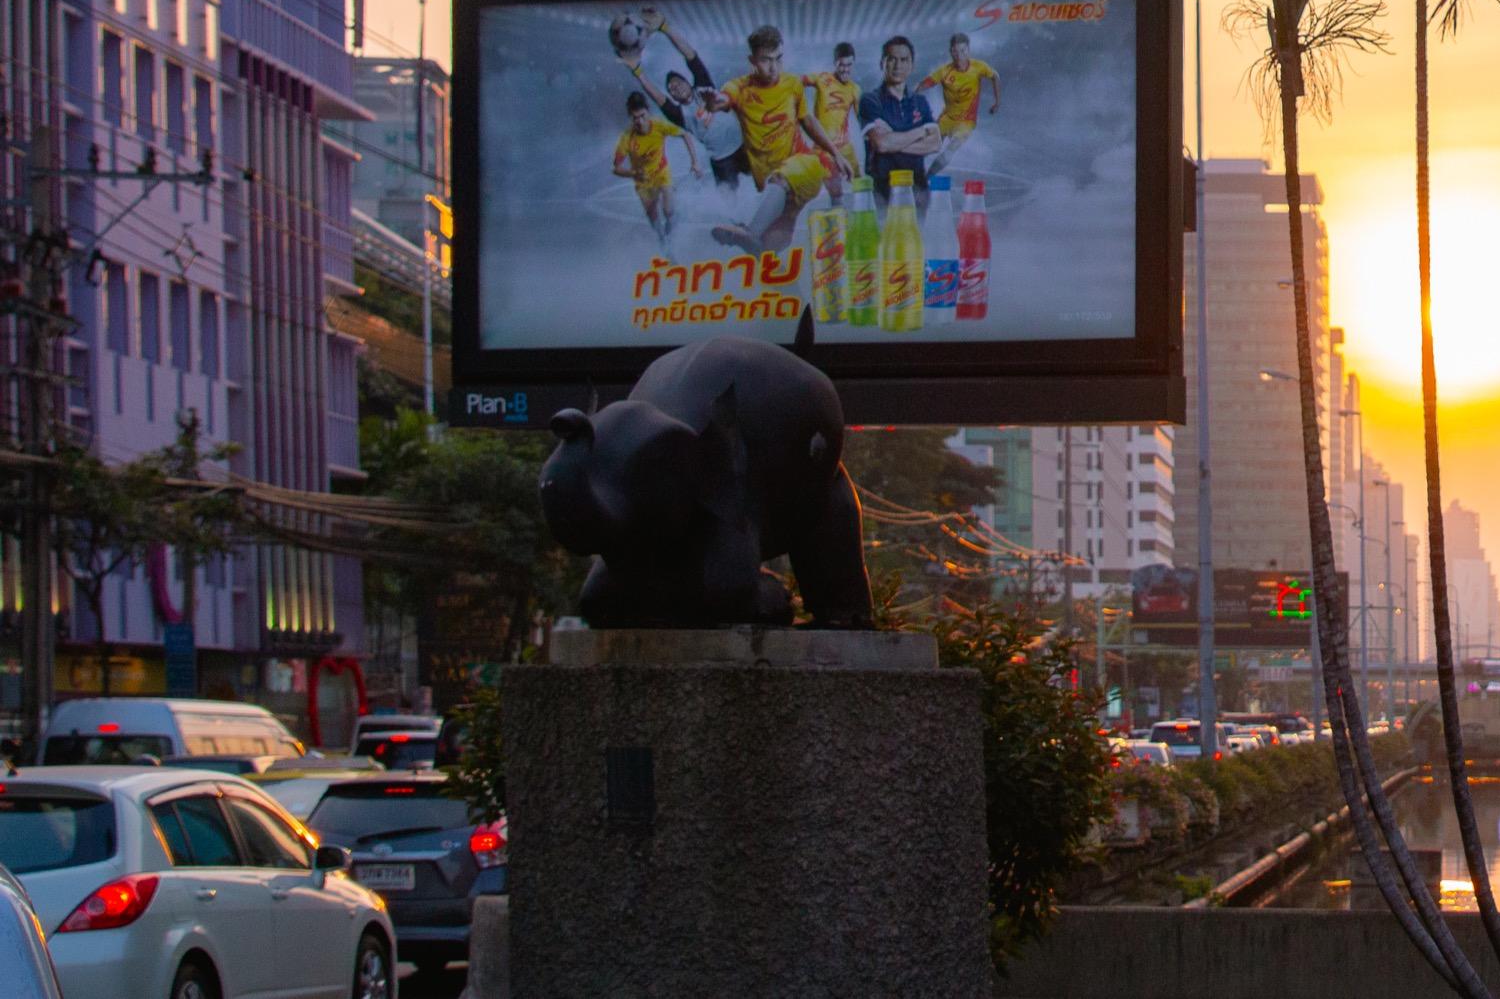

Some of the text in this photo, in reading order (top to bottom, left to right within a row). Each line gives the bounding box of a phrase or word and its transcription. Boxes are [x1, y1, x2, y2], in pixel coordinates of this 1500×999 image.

[633, 247, 804, 299] ท้าทาย
[633, 292, 801, 330] ทุกขีดจำกัด
